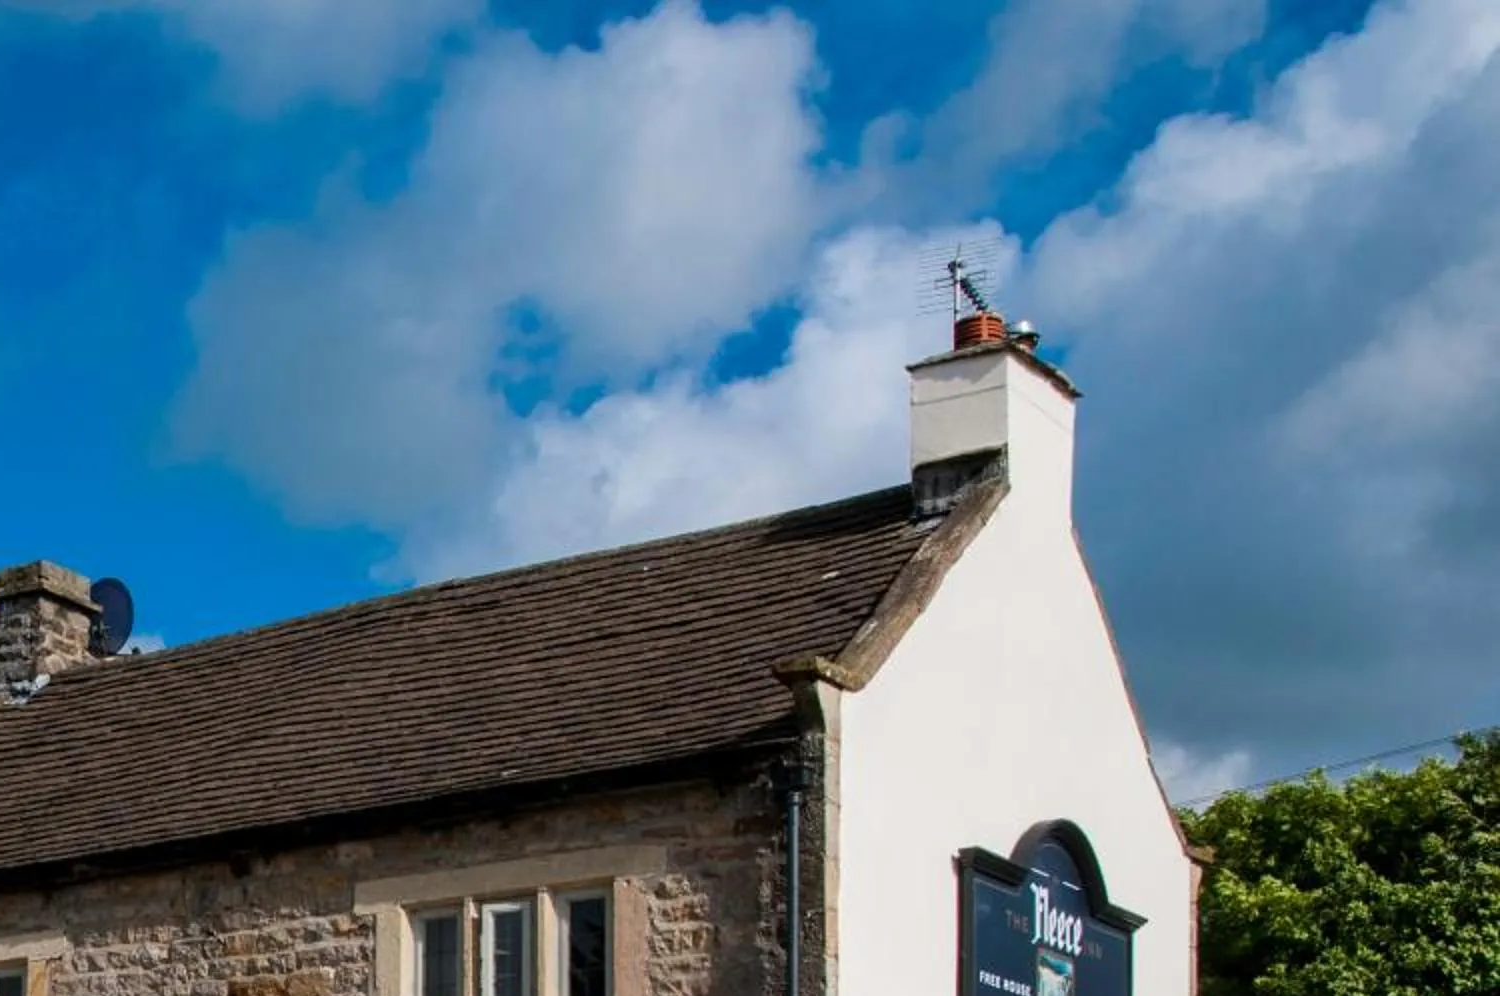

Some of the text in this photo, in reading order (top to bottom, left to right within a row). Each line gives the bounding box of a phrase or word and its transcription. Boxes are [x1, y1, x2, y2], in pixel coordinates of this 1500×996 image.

[1005, 909, 1029, 933] THE
[1030, 883, 1083, 956] Fleece
[979, 970, 1001, 989] FREE
